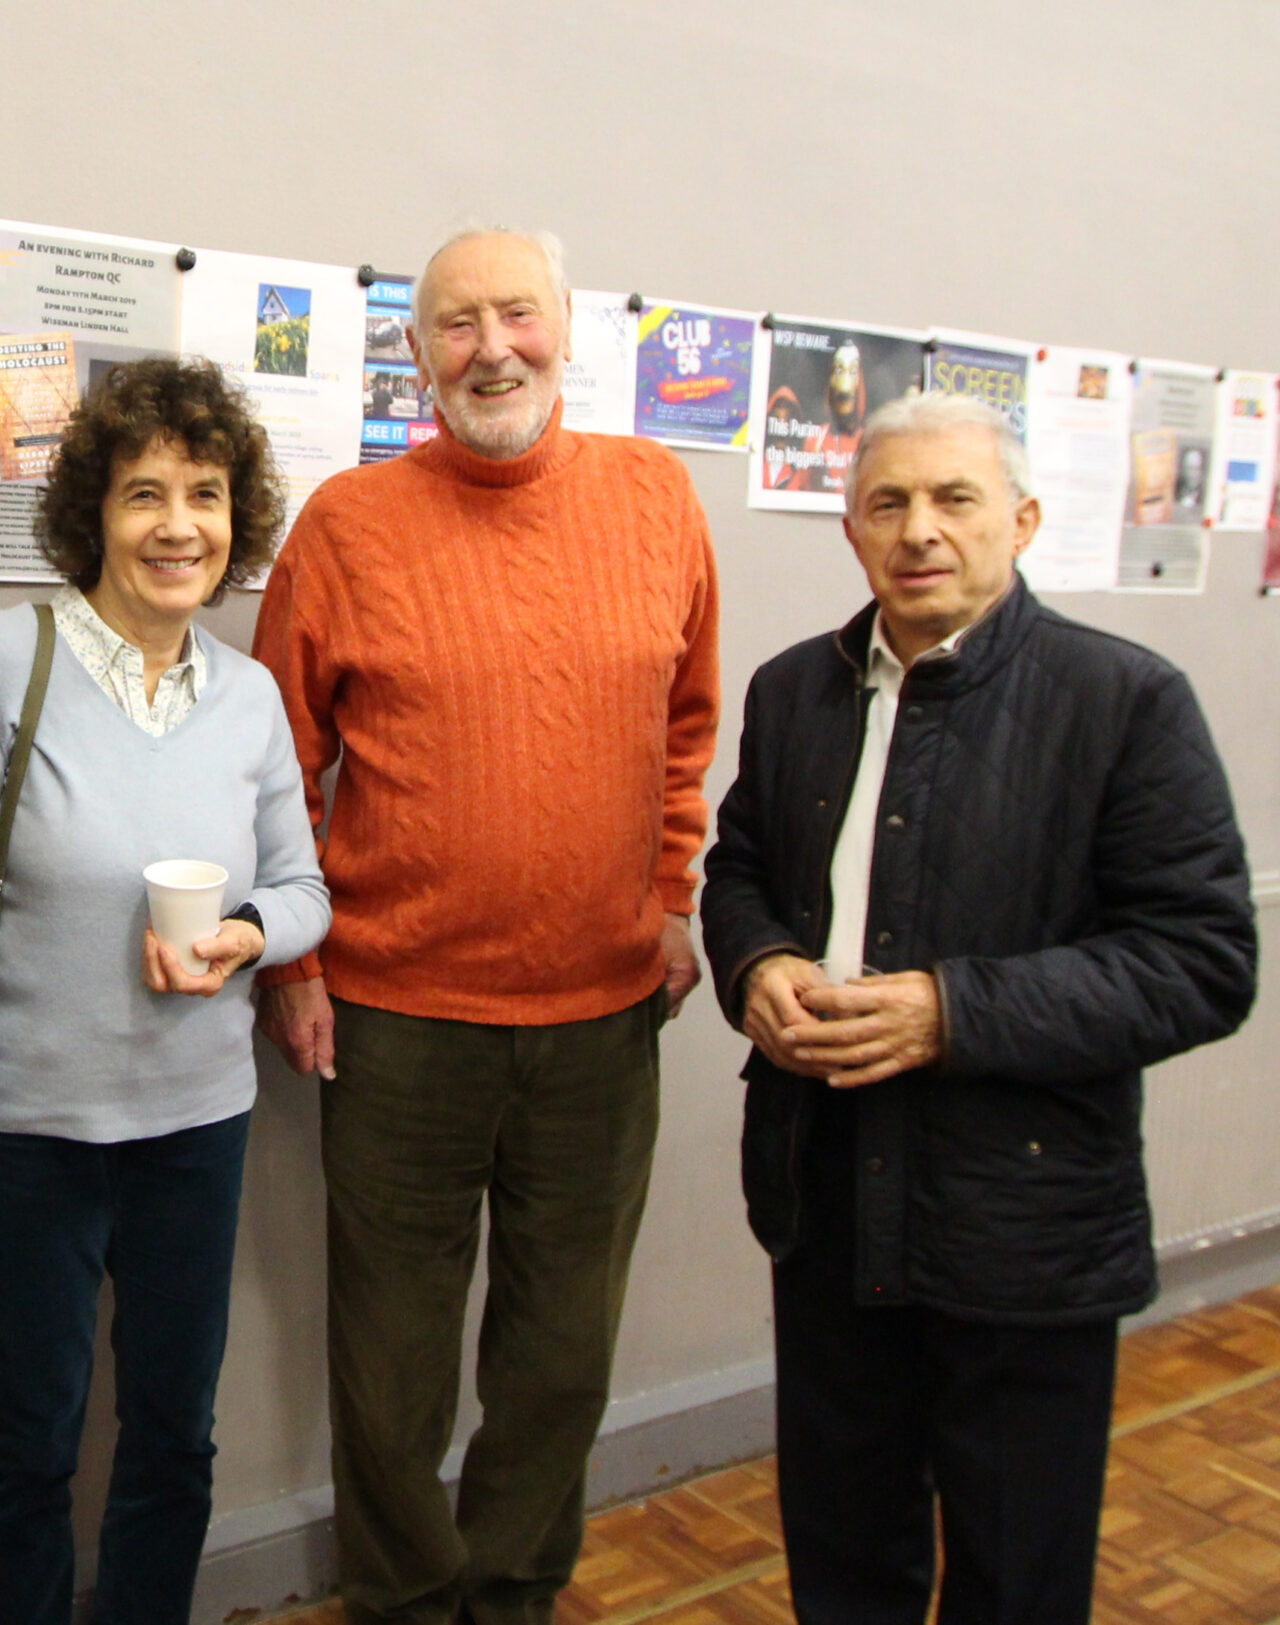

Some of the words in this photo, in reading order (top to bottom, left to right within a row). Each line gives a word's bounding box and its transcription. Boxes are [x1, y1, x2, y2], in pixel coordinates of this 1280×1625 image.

[106, 271, 122, 285] QC
[382, 285, 408, 300] THIS
[661, 318, 712, 350] CLUB
[47, 341, 66, 351] THE
[364, 425, 389, 439] SEE
[393, 426, 405, 440] IT
[767, 415, 789, 437] This
